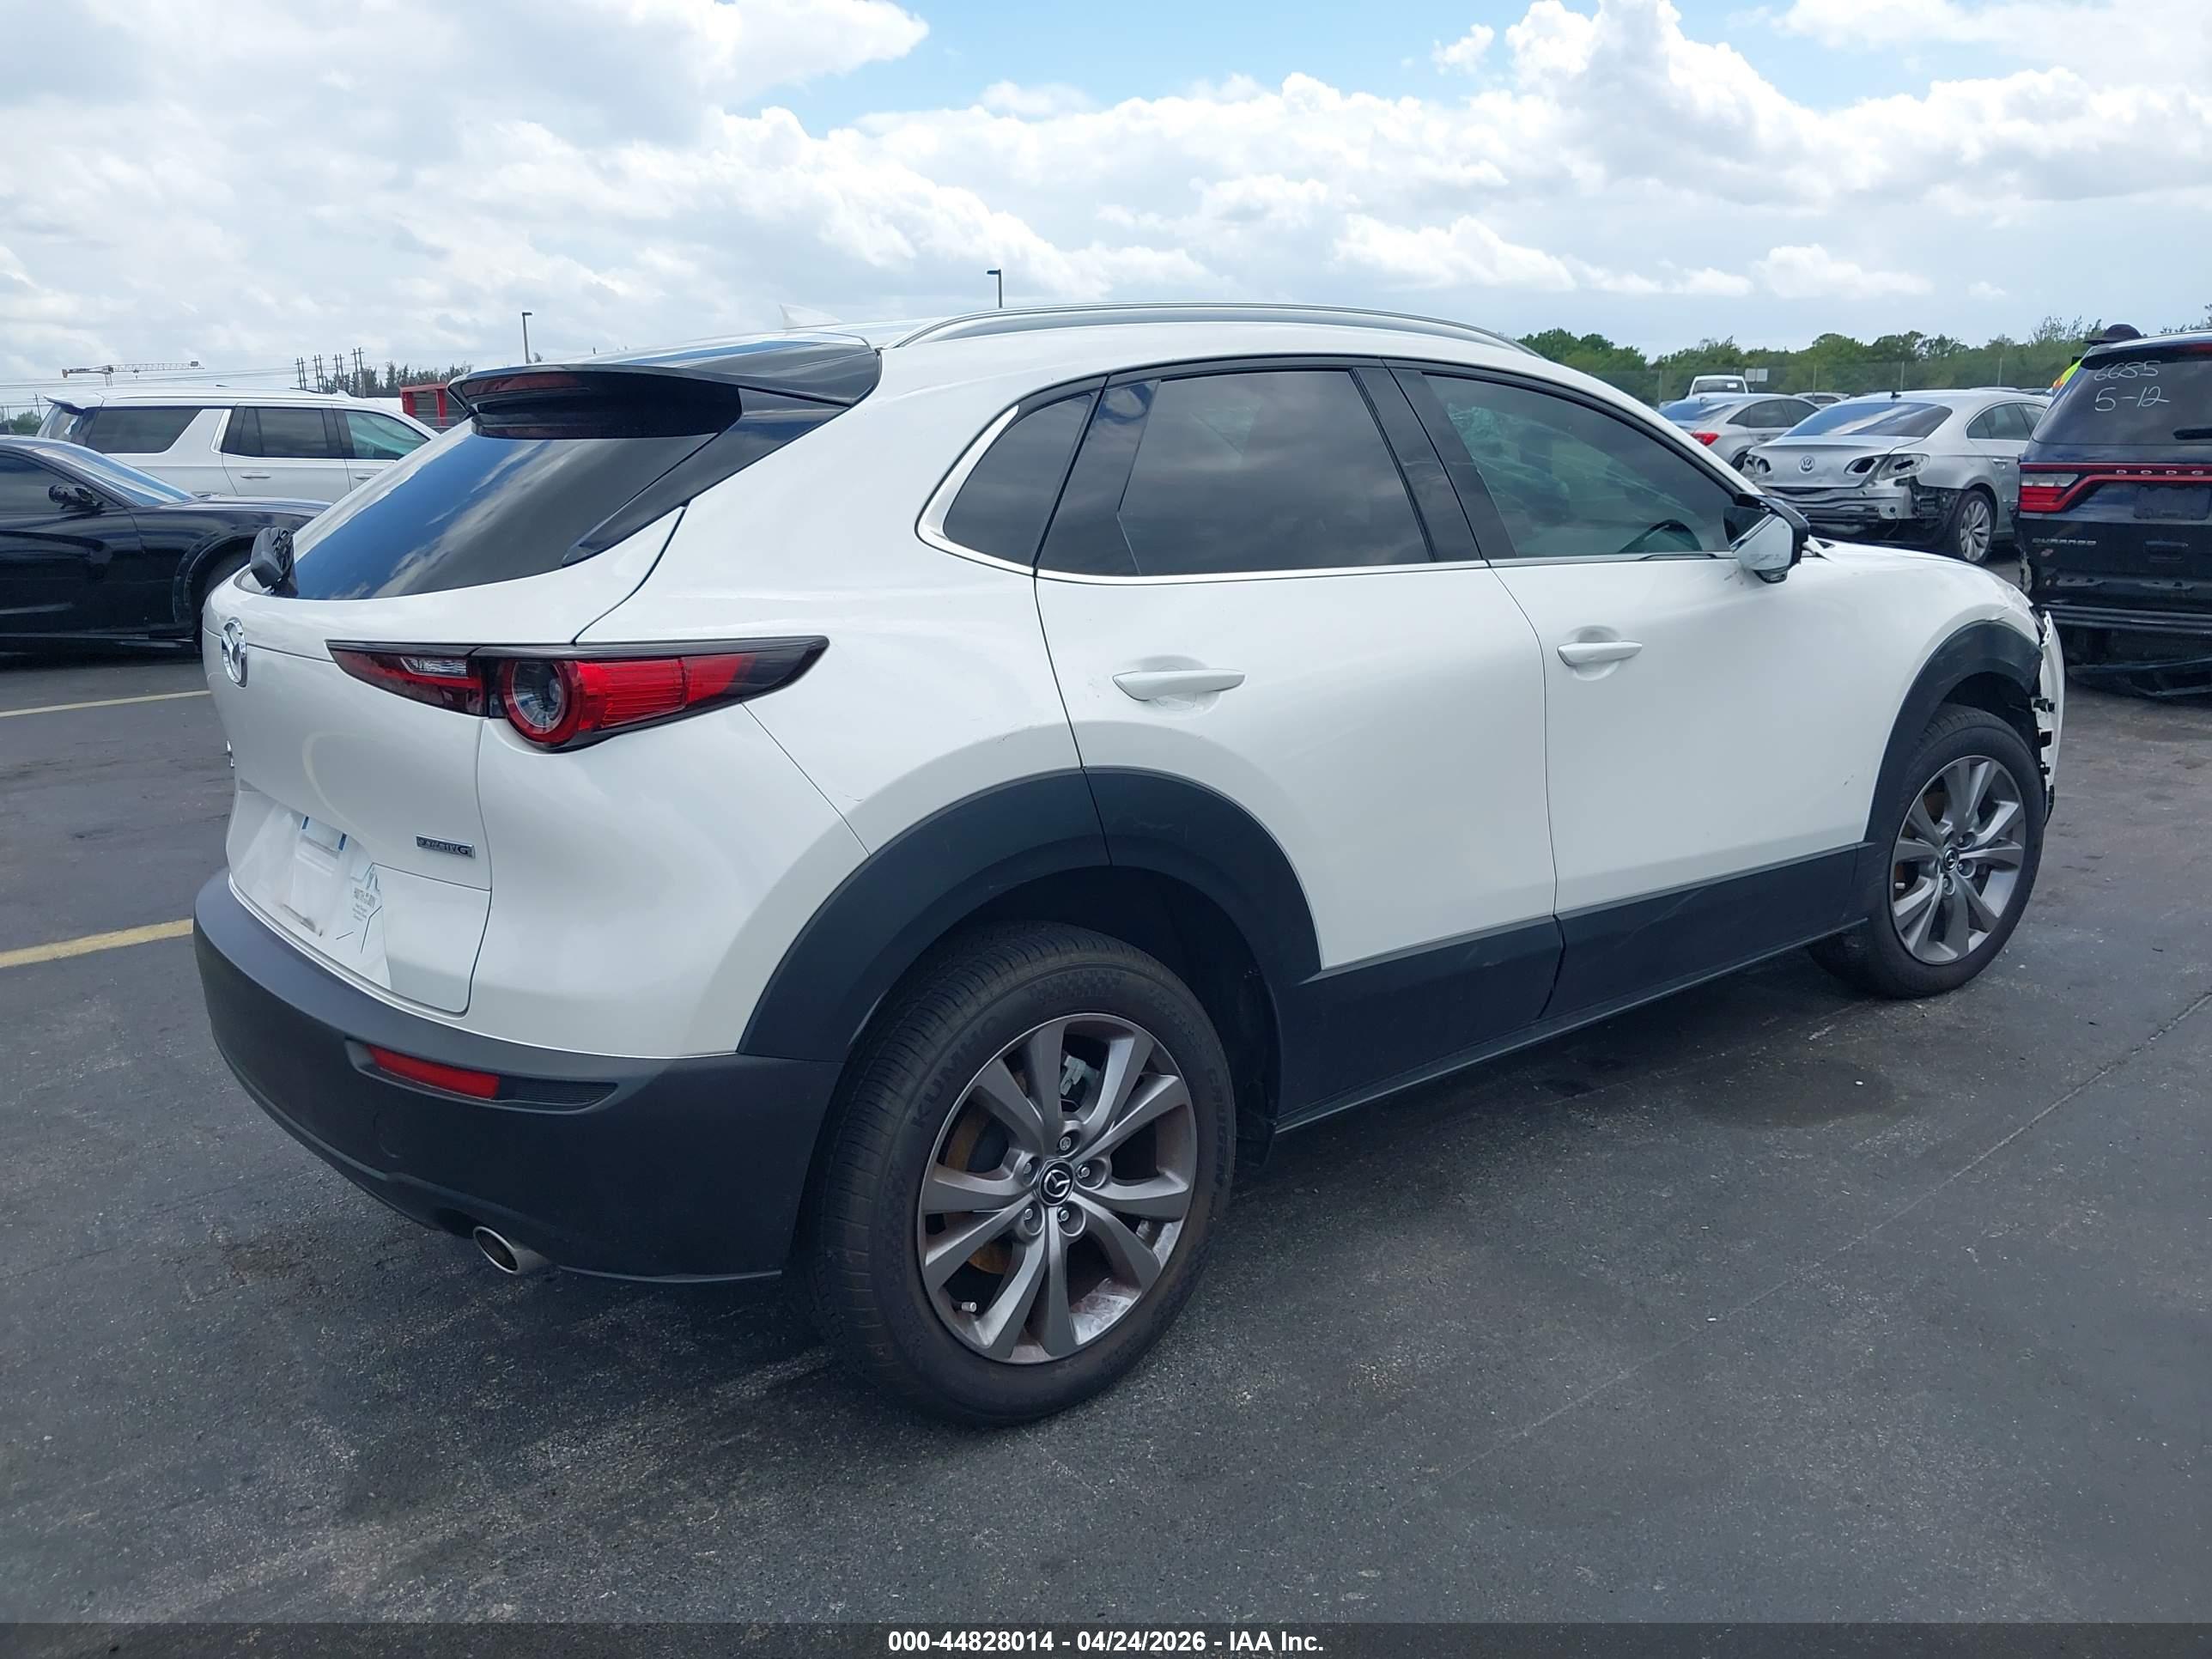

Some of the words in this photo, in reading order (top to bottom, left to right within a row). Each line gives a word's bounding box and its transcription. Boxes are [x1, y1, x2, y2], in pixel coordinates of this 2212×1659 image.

[2094, 360, 2161, 380] 6685
[2094, 386, 2171, 411] 5-12
[1799, 455, 1814, 473] VW
[911, 1015, 1001, 1128] KUMHO
